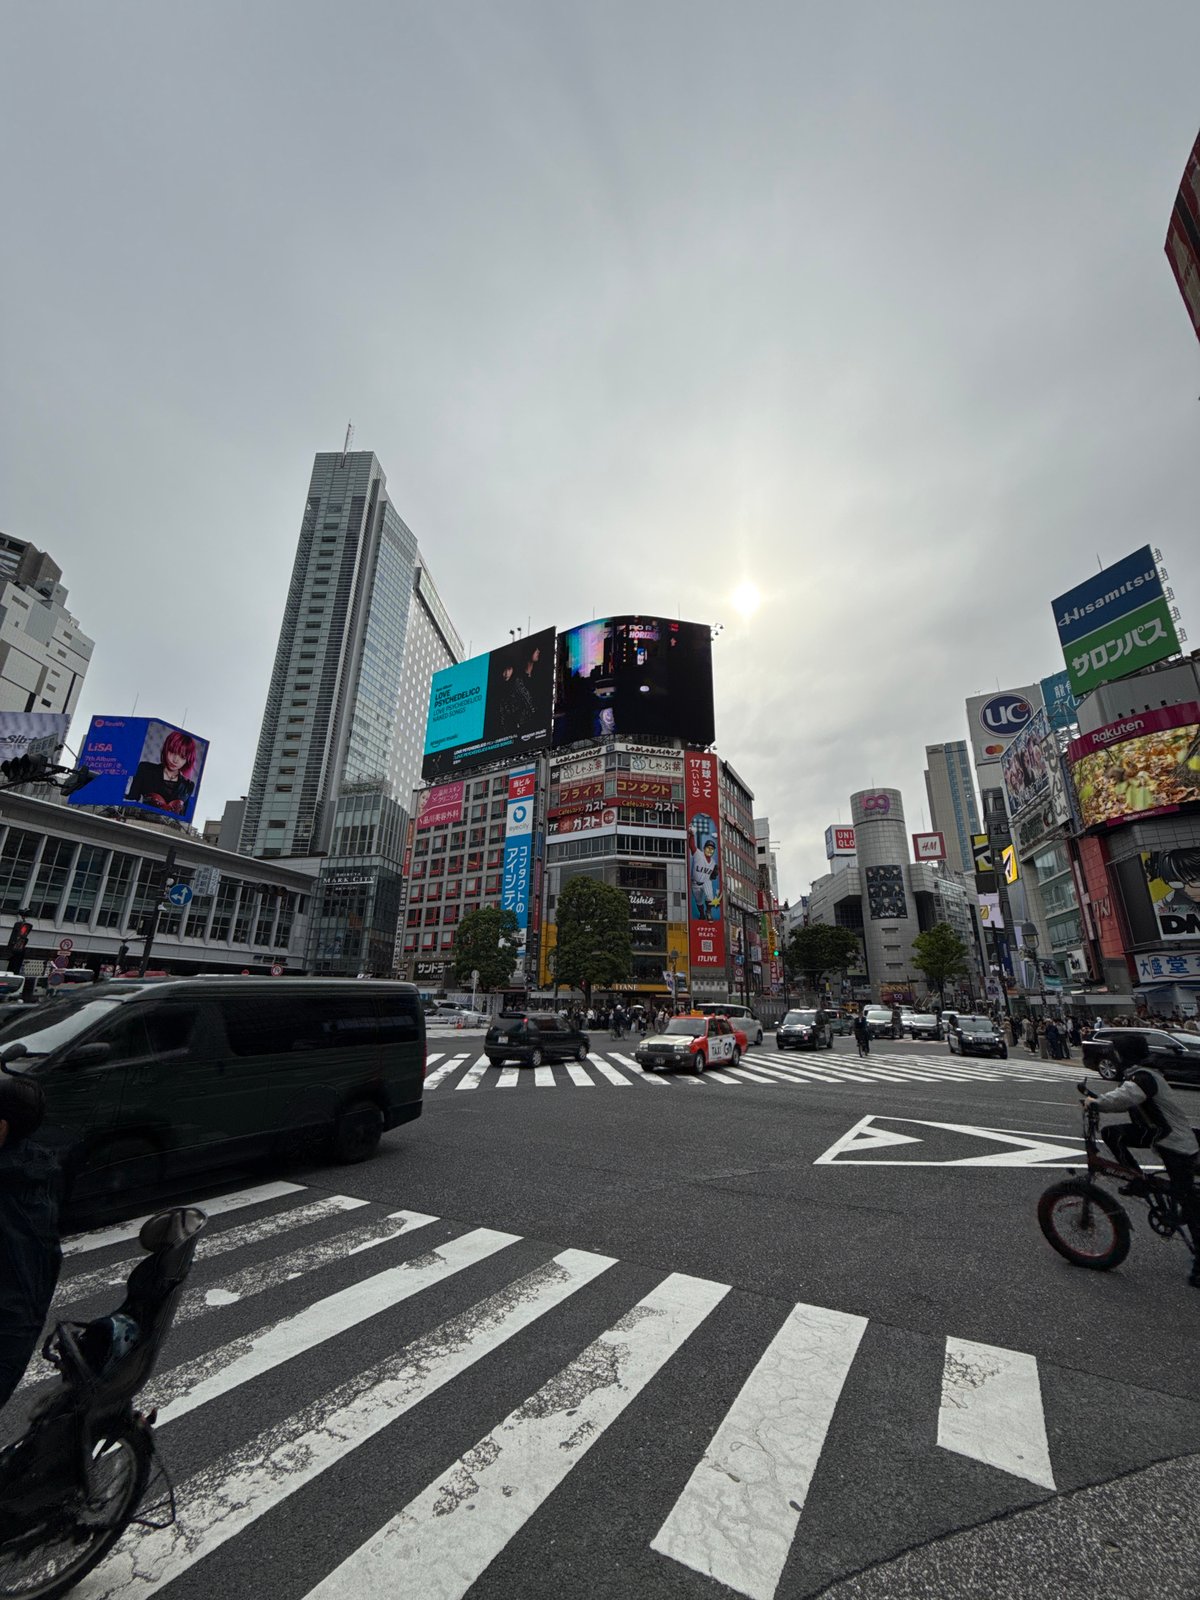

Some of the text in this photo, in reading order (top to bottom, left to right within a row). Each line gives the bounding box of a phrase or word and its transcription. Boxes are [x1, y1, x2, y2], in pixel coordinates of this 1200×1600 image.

[1058, 569, 1156, 627] Hisamitsu
[1072, 618, 1167, 677] サロンパス
[434, 686, 481, 708] PSYCHEDELICO
[435, 690, 450, 701] LOVE
[985, 702, 1029, 727] UC
[1092, 719, 1144, 744] Rakuten
[88, 743, 113, 752] LiSA
[648, 759, 682, 772] しゃぶ葉
[701, 759, 712, 798] 野球って
[517, 787, 526, 796] 5F
[618, 781, 669, 795] コンタクト
[585, 800, 607, 812] ガスト
[654, 802, 679, 812] ガスト
[509, 822, 529, 832] eyecity
[549, 823, 559, 831] 7F
[573, 816, 600, 830] ガスト
[837, 831, 853, 839] UNI
[838, 839, 855, 847] QLO
[922, 841, 937, 851] H&M
[504, 848, 518, 911] アイシティ
[516, 846, 528, 913] コンタクトの
